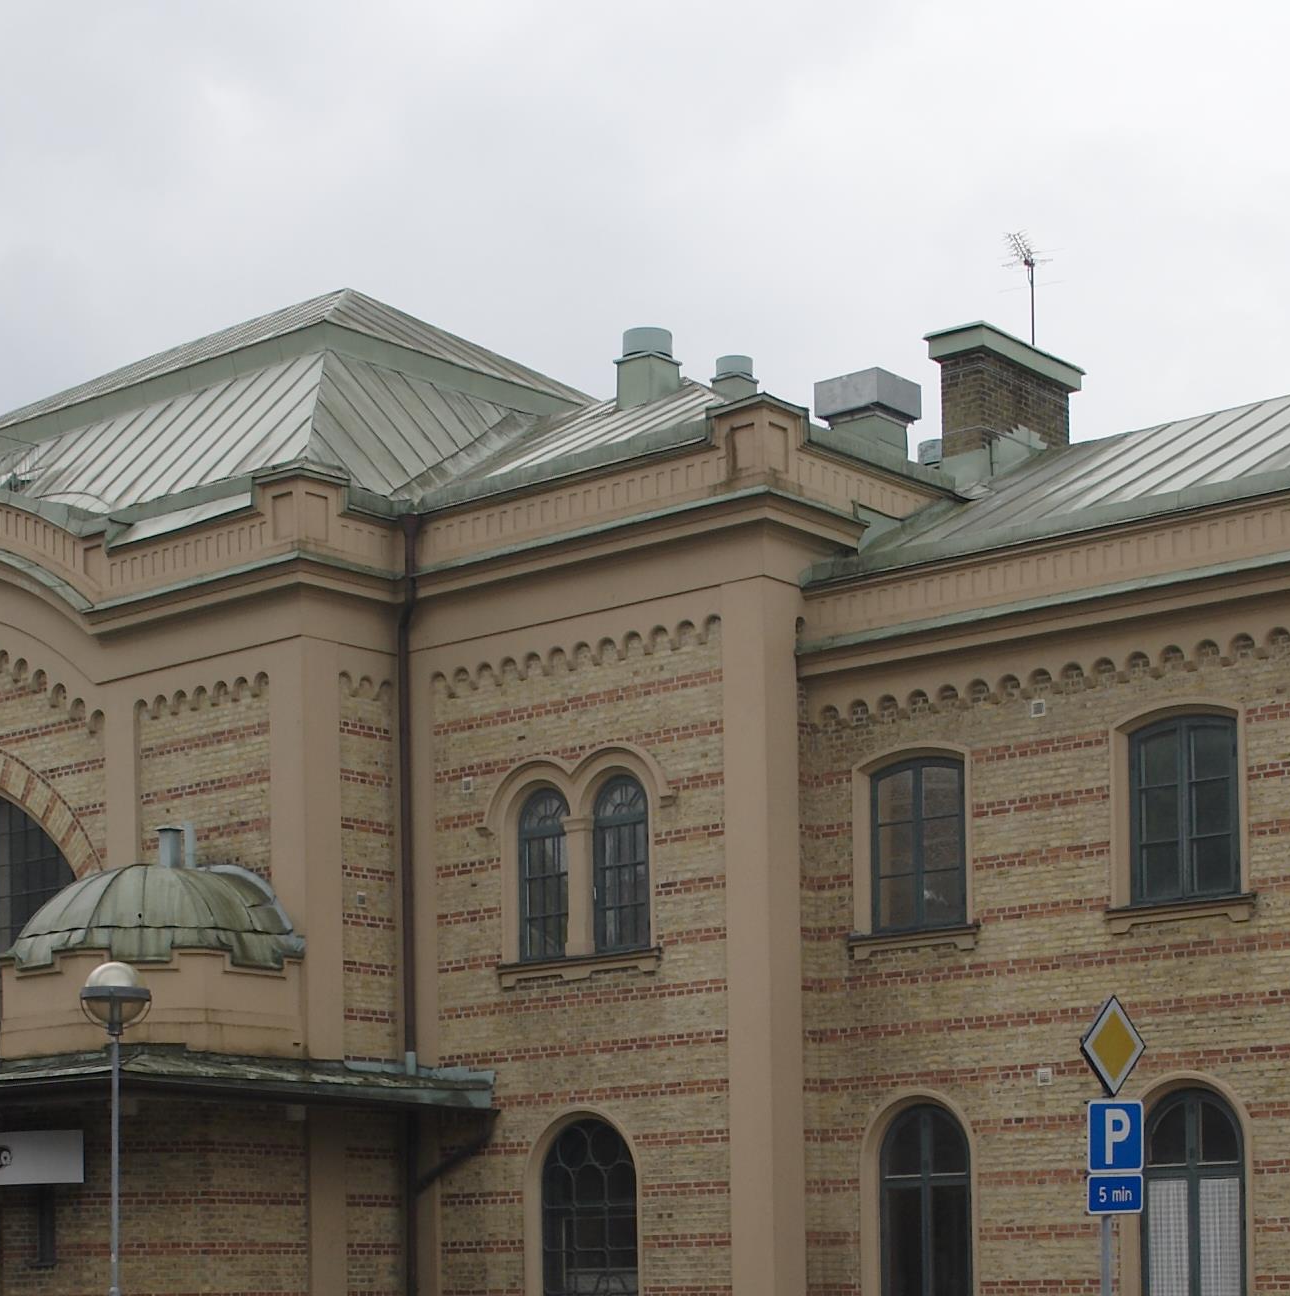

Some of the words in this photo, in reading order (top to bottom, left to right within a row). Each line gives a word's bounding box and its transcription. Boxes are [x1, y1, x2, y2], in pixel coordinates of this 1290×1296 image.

[1105, 1108, 1131, 1165] P
[1098, 1186, 1107, 1203] 5
[1112, 1186, 1133, 1203] min
